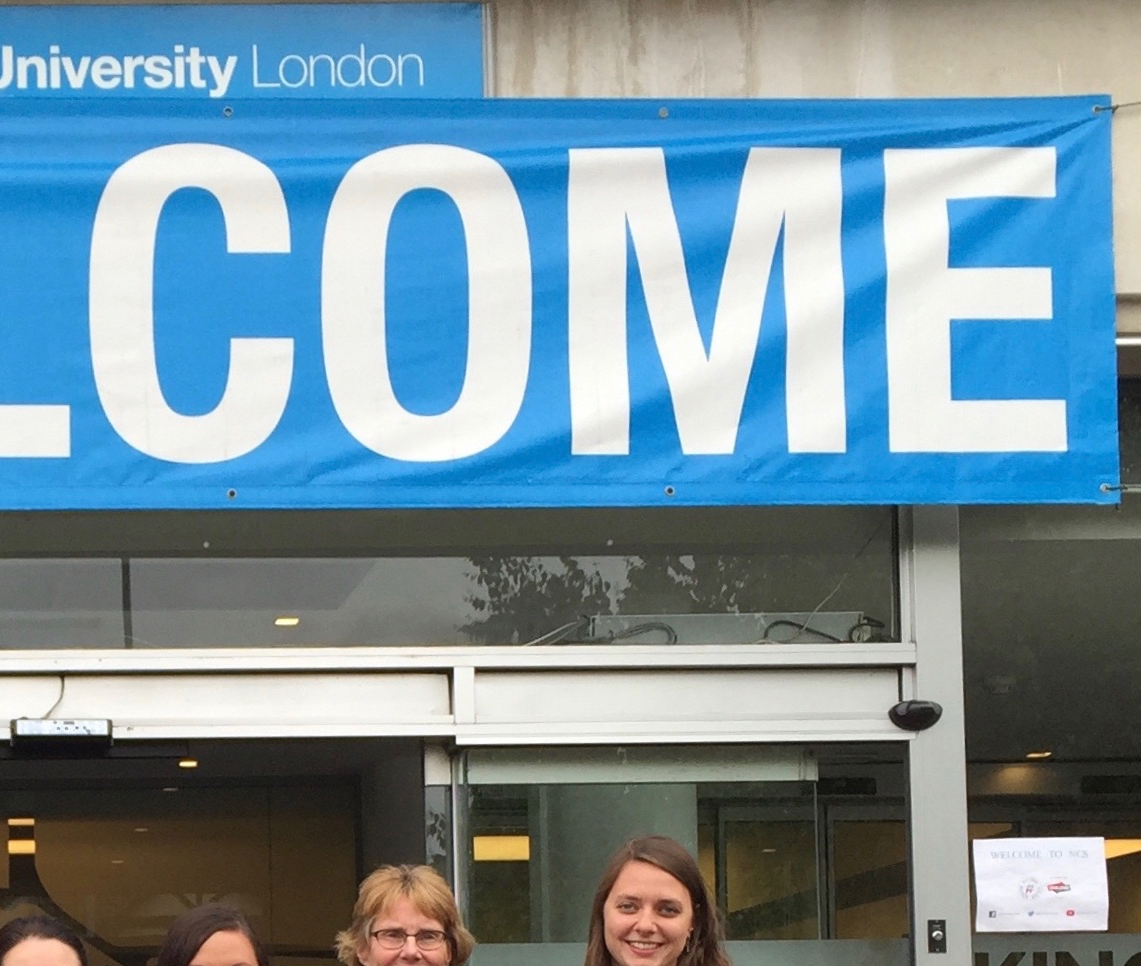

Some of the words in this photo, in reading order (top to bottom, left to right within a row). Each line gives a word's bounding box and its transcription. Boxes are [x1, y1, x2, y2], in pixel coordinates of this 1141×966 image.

[252, 43, 424, 88] London
[990, 850, 1042, 860] WELCOME
[1050, 850, 1063, 858] TO
